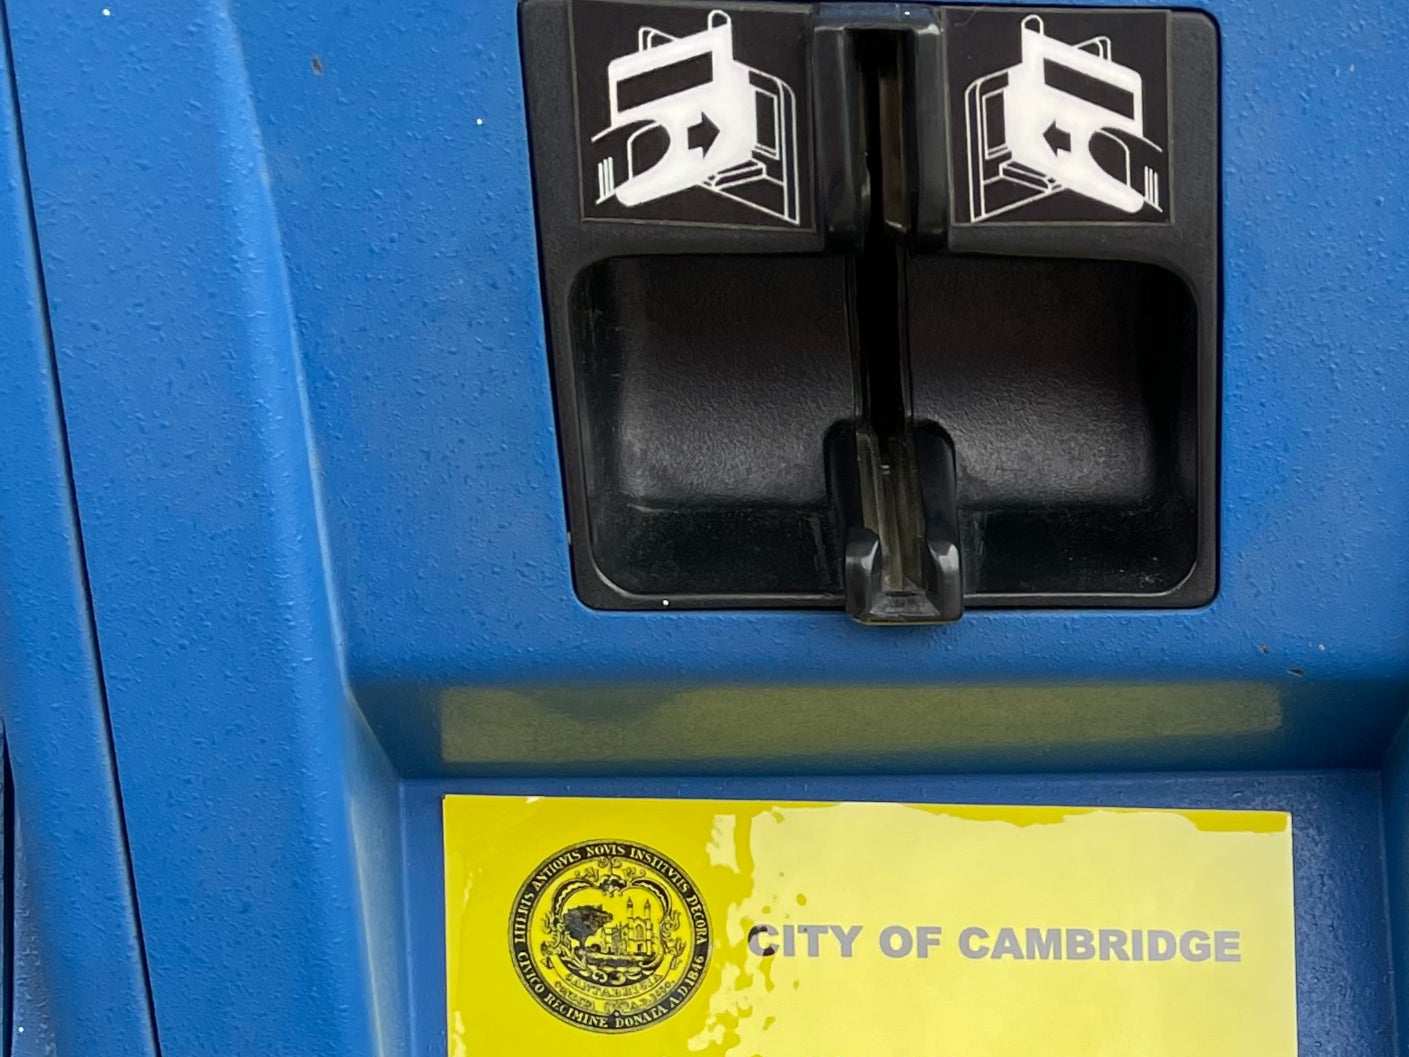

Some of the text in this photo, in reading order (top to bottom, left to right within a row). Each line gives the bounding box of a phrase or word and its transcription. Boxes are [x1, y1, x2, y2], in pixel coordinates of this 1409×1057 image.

[586, 843, 626, 857] NOVIS
[686, 894, 708, 945] DECORA
[747, 924, 1242, 963] CITY OF CAMBRIDGE
[517, 951, 545, 993] CIVICO
[615, 1004, 669, 1029] DONATA
